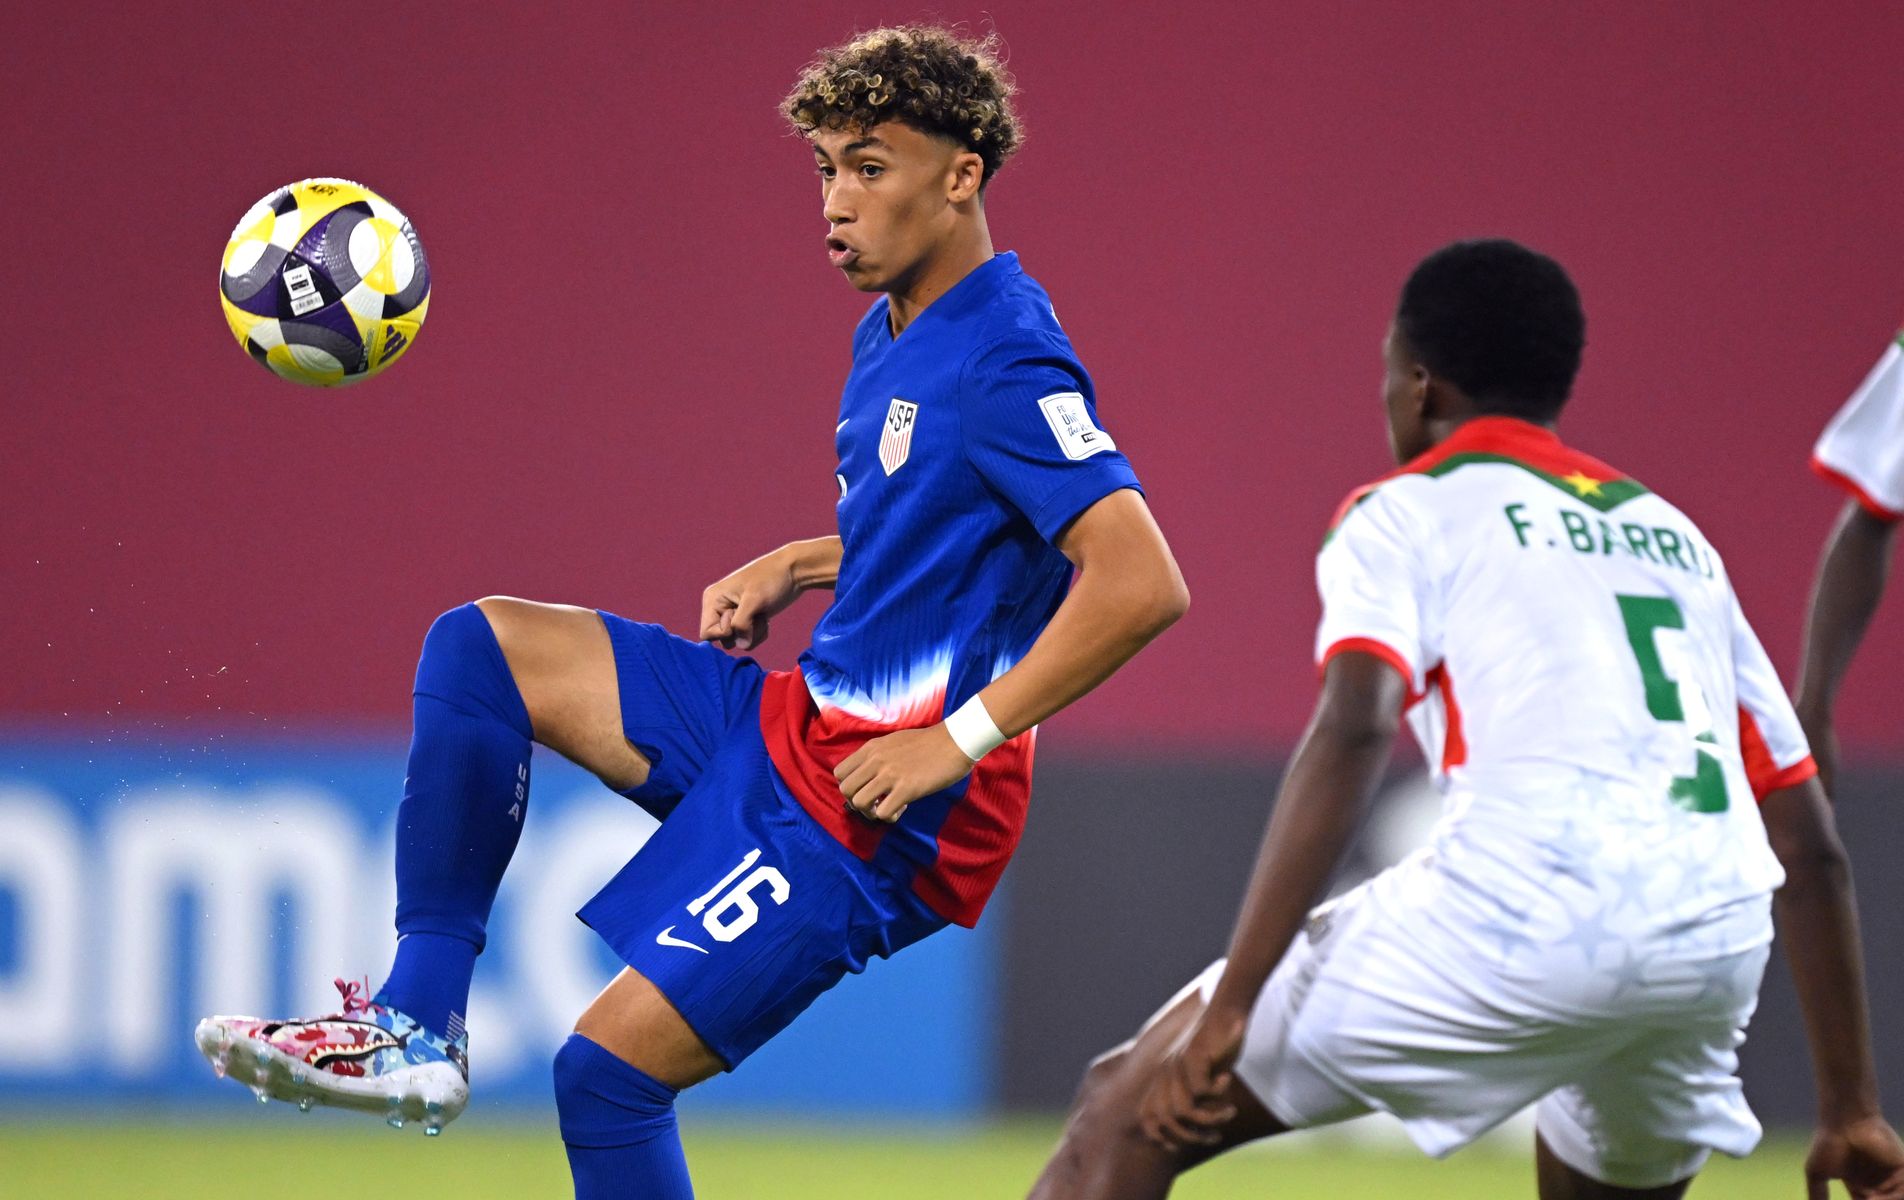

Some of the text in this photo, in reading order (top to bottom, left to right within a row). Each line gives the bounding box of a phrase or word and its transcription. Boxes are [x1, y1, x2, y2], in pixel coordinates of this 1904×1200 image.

[889, 403, 914, 432] USA
[1614, 593, 1730, 814] 5
[507, 762, 527, 822] USA
[686, 848, 791, 942] 16
